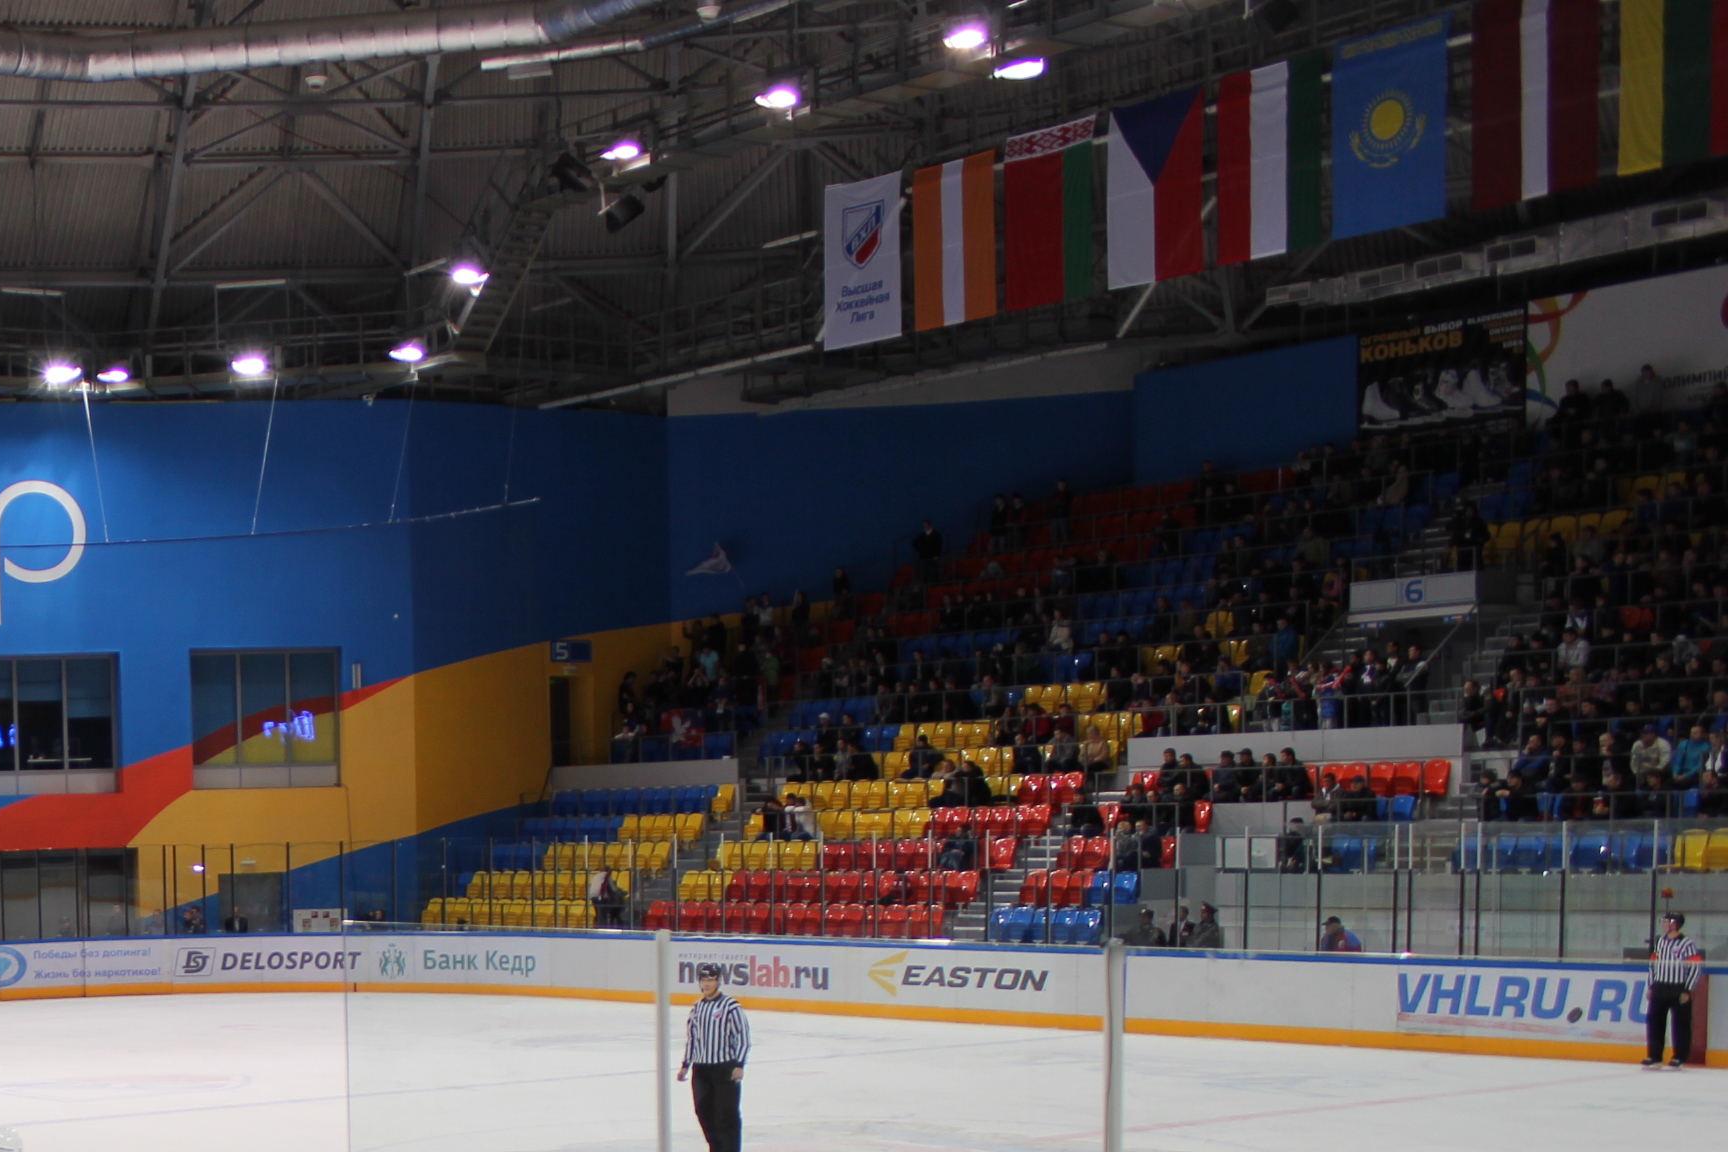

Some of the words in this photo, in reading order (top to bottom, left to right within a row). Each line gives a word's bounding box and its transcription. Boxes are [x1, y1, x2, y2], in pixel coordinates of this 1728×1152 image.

[841, 280, 884, 297] Высшая
[835, 292, 890, 312] Хоккейная
[850, 311, 875, 323] Лига
[1423, 319, 1464, 335] ВЫБОР
[1360, 331, 1464, 363] КОНЬКОВ
[1404, 579, 1424, 603] 6
[555, 641, 569, 660] 5
[33, 950, 77, 960] Победы
[80, 948, 100, 958] без
[102, 948, 151, 959] допинга!
[221, 950, 362, 971] DELOSPORT
[423, 949, 478, 970] Банк
[485, 949, 537, 977] Кедр
[34, 970, 70, 979] Жизнь
[72, 968, 92, 978] без
[94, 966, 161, 978] наркотиков!
[901, 965, 1050, 991] EASTON
